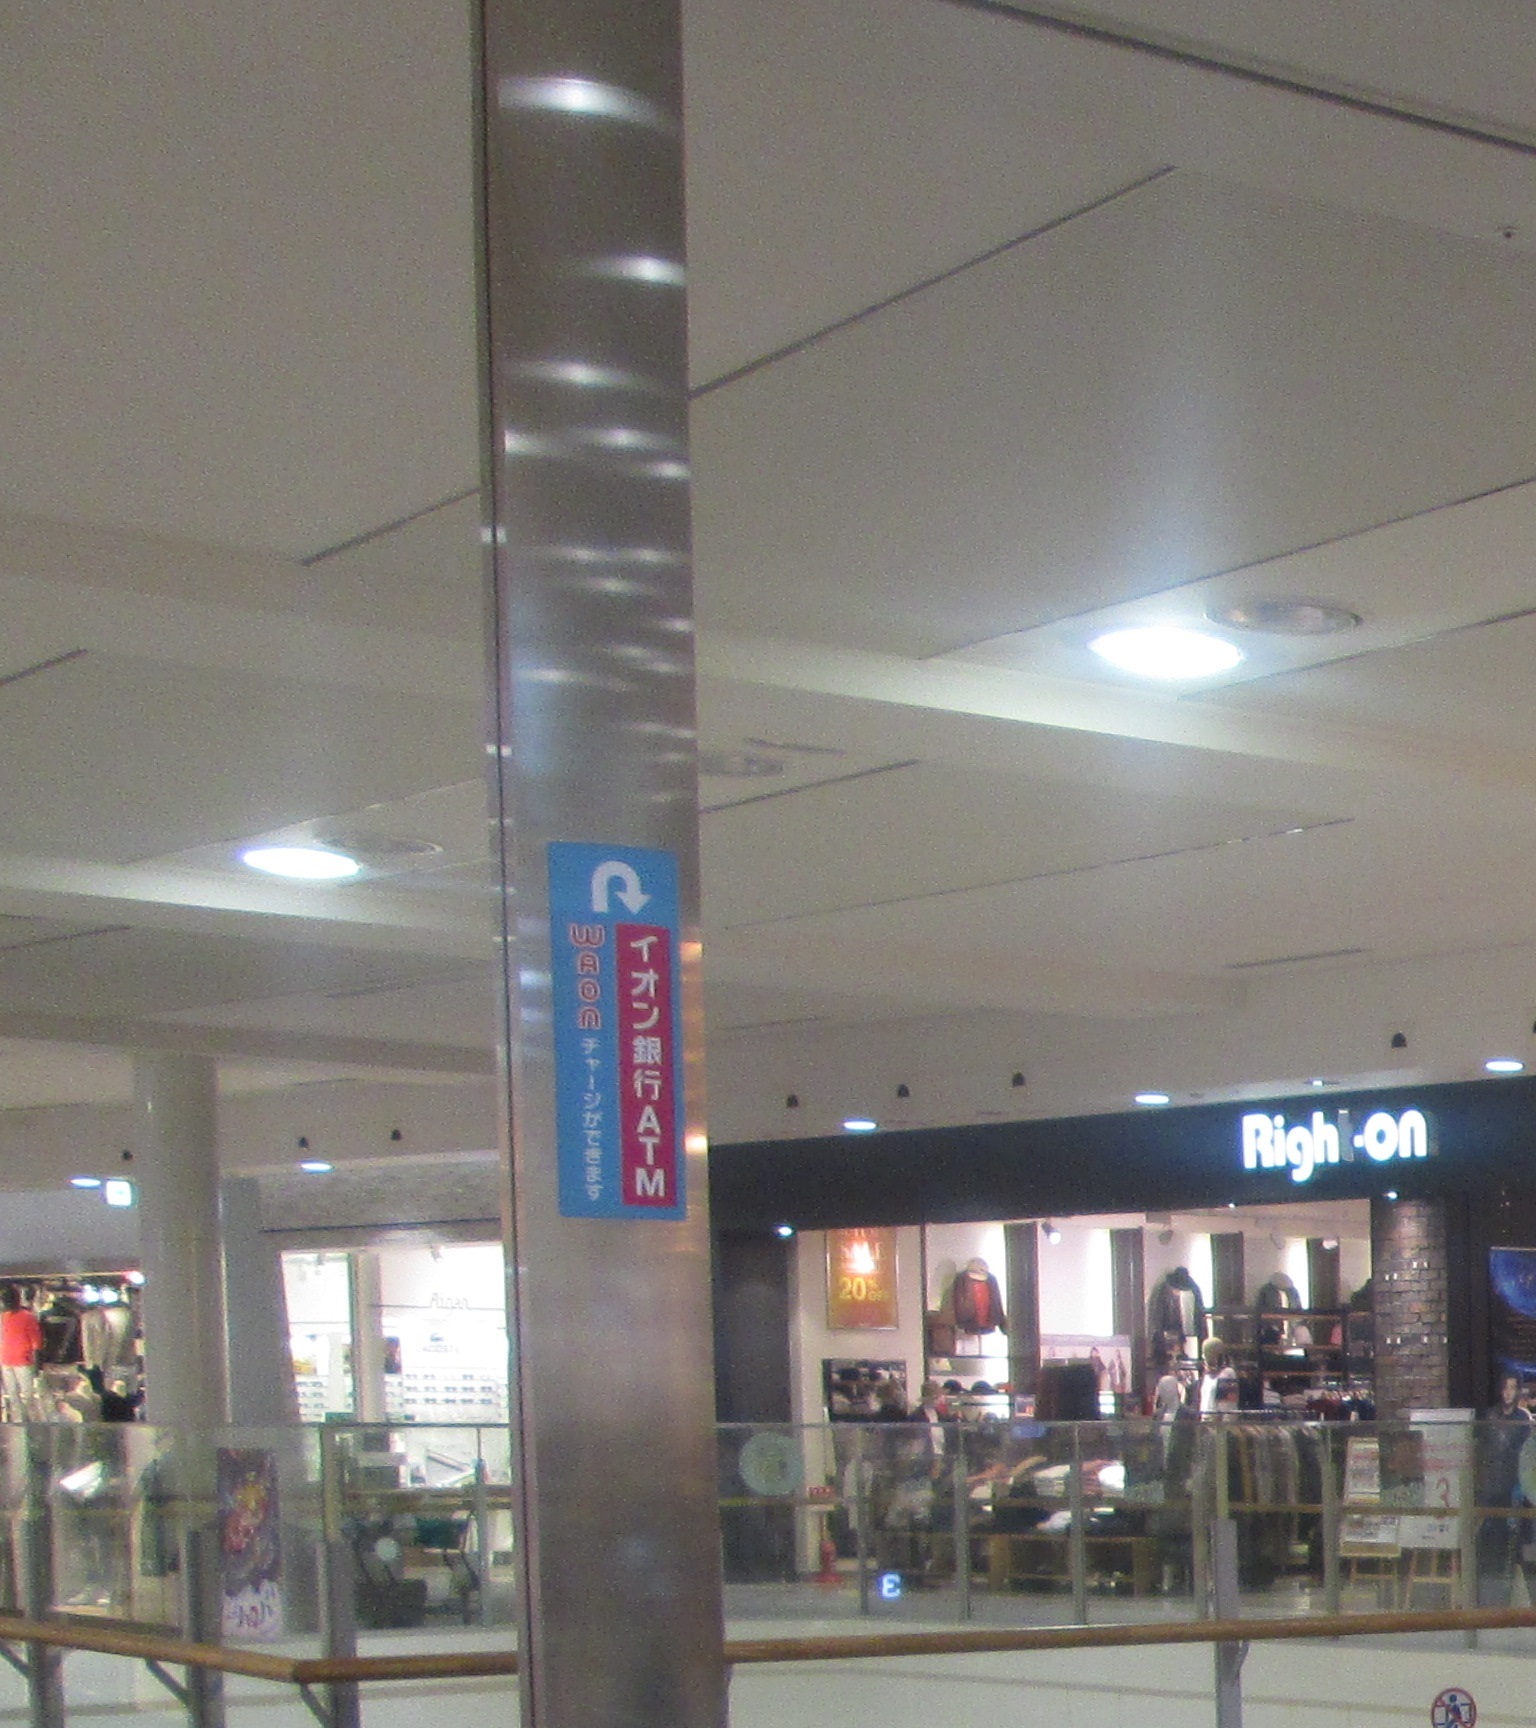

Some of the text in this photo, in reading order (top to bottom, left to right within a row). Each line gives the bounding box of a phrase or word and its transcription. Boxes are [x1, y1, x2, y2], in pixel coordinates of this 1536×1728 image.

[629, 934, 665, 1199] イオン銀行ATM
